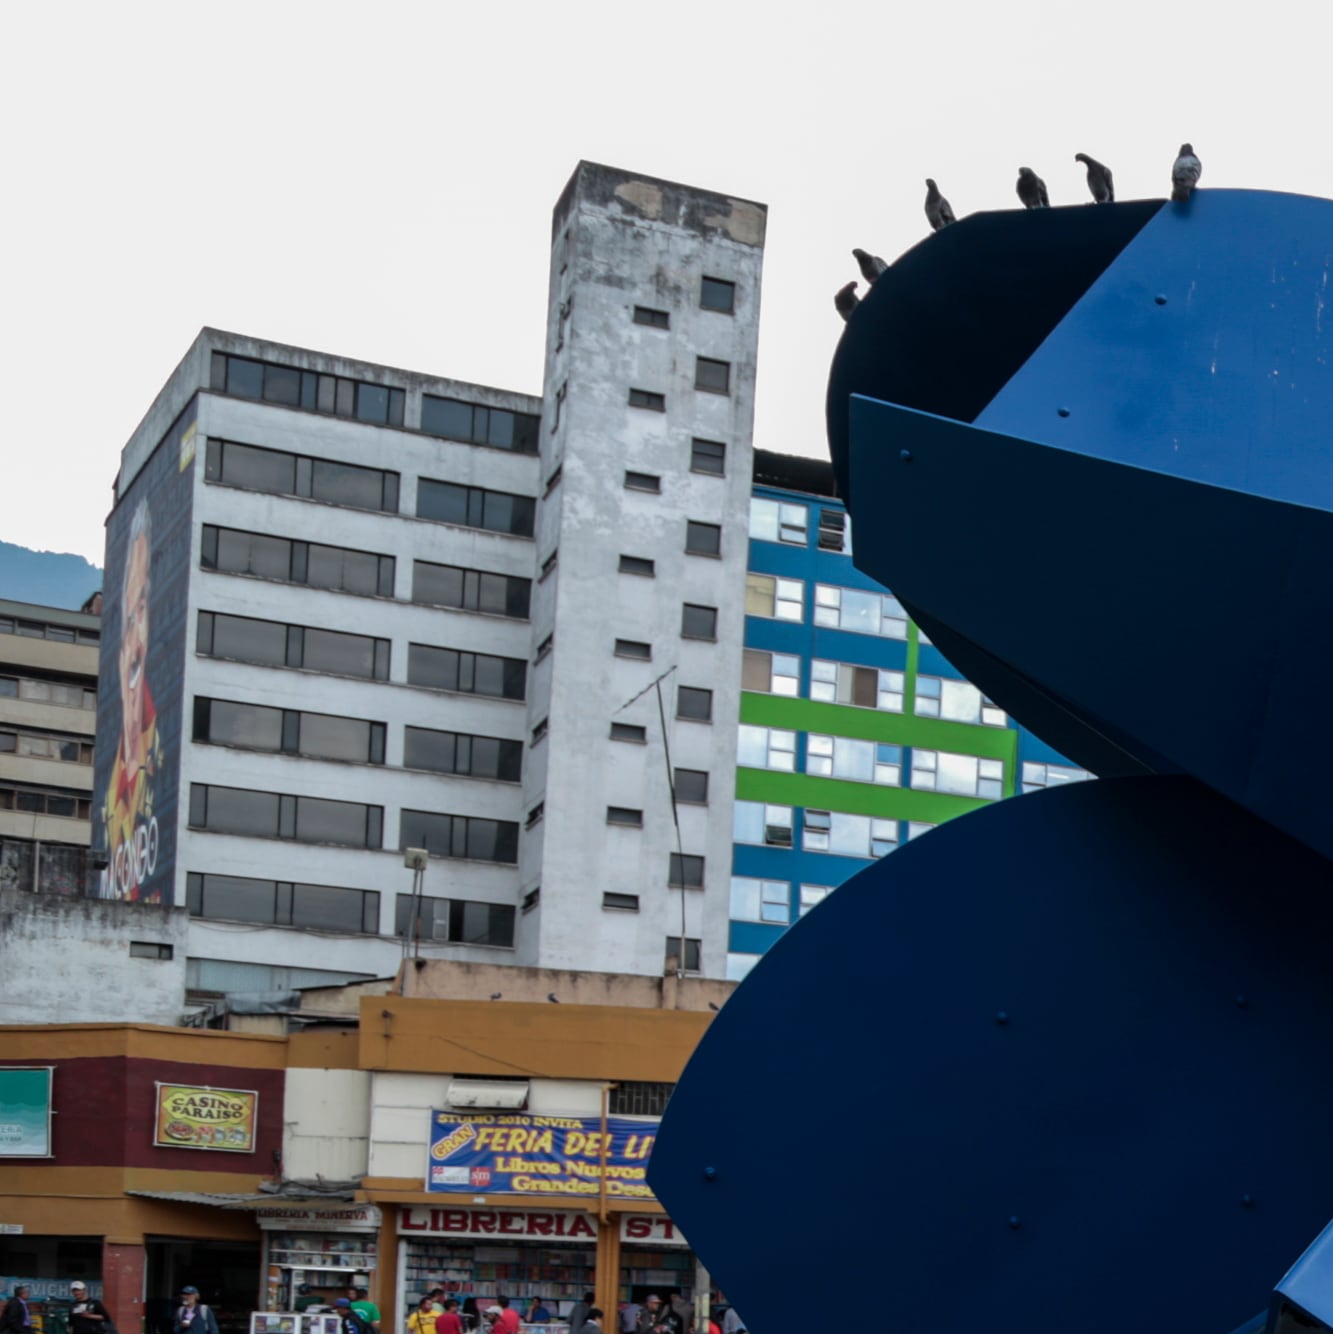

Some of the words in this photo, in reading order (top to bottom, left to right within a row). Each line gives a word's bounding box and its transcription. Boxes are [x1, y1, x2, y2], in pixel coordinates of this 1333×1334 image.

[172, 1097, 243, 1111] CASINO
[172, 1105, 243, 1119] PARAISO
[434, 1126, 475, 1158] GRAN
[474, 1127, 553, 1153] FERIA
[564, 1131, 613, 1157] DEL
[624, 1135, 656, 1158] LI
[496, 1157, 560, 1174] Libros
[512, 1176, 600, 1194] Grandes
[401, 1207, 597, 1237] LIBRERIA
